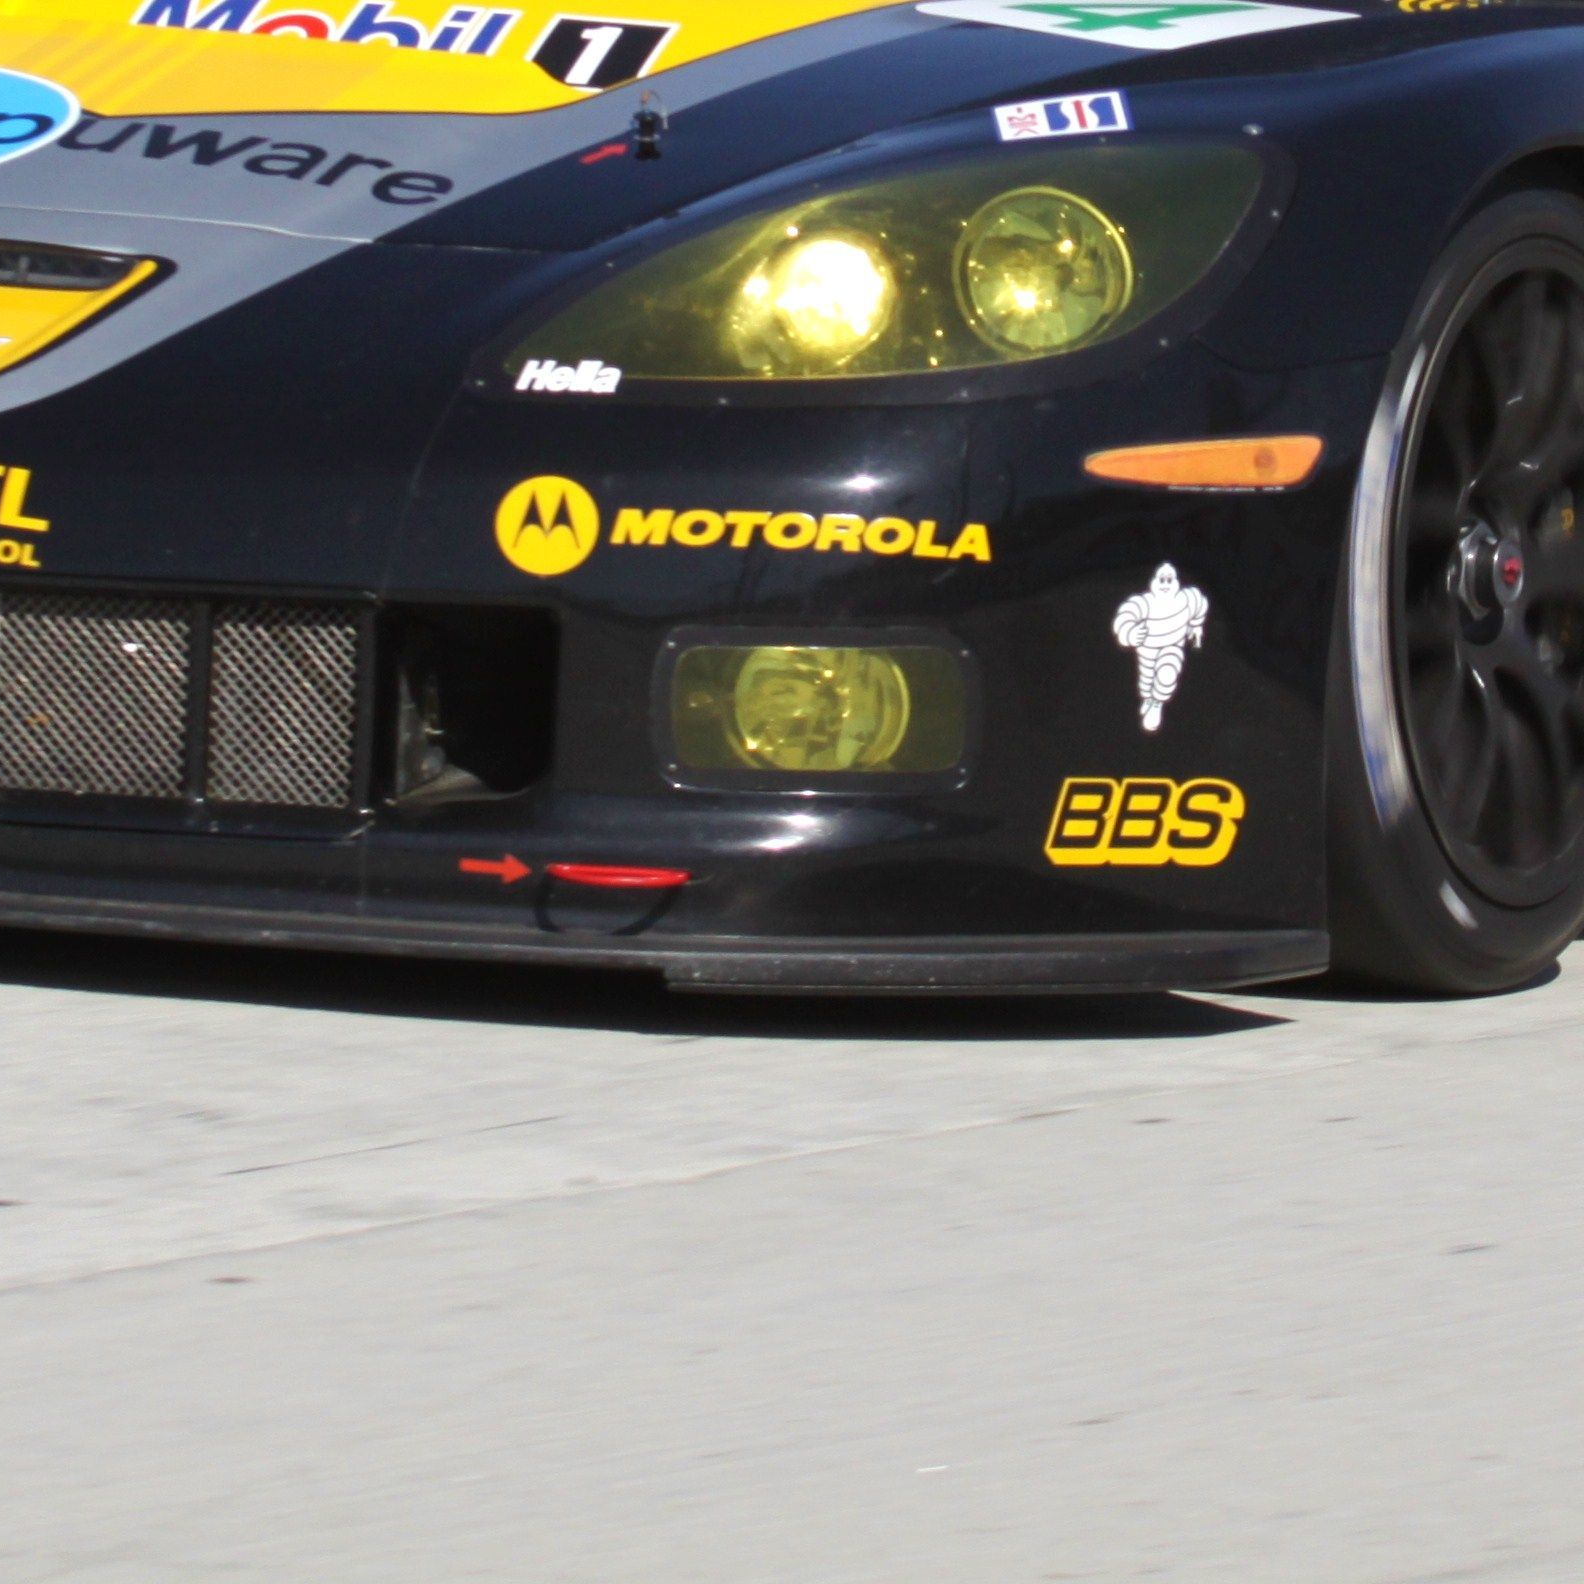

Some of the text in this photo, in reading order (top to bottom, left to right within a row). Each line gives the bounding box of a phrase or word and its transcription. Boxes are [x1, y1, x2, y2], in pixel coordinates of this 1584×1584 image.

[515, 359, 622, 395] Hella
[609, 505, 993, 563] MOTOROLA
[1044, 776, 1246, 866] BBS
